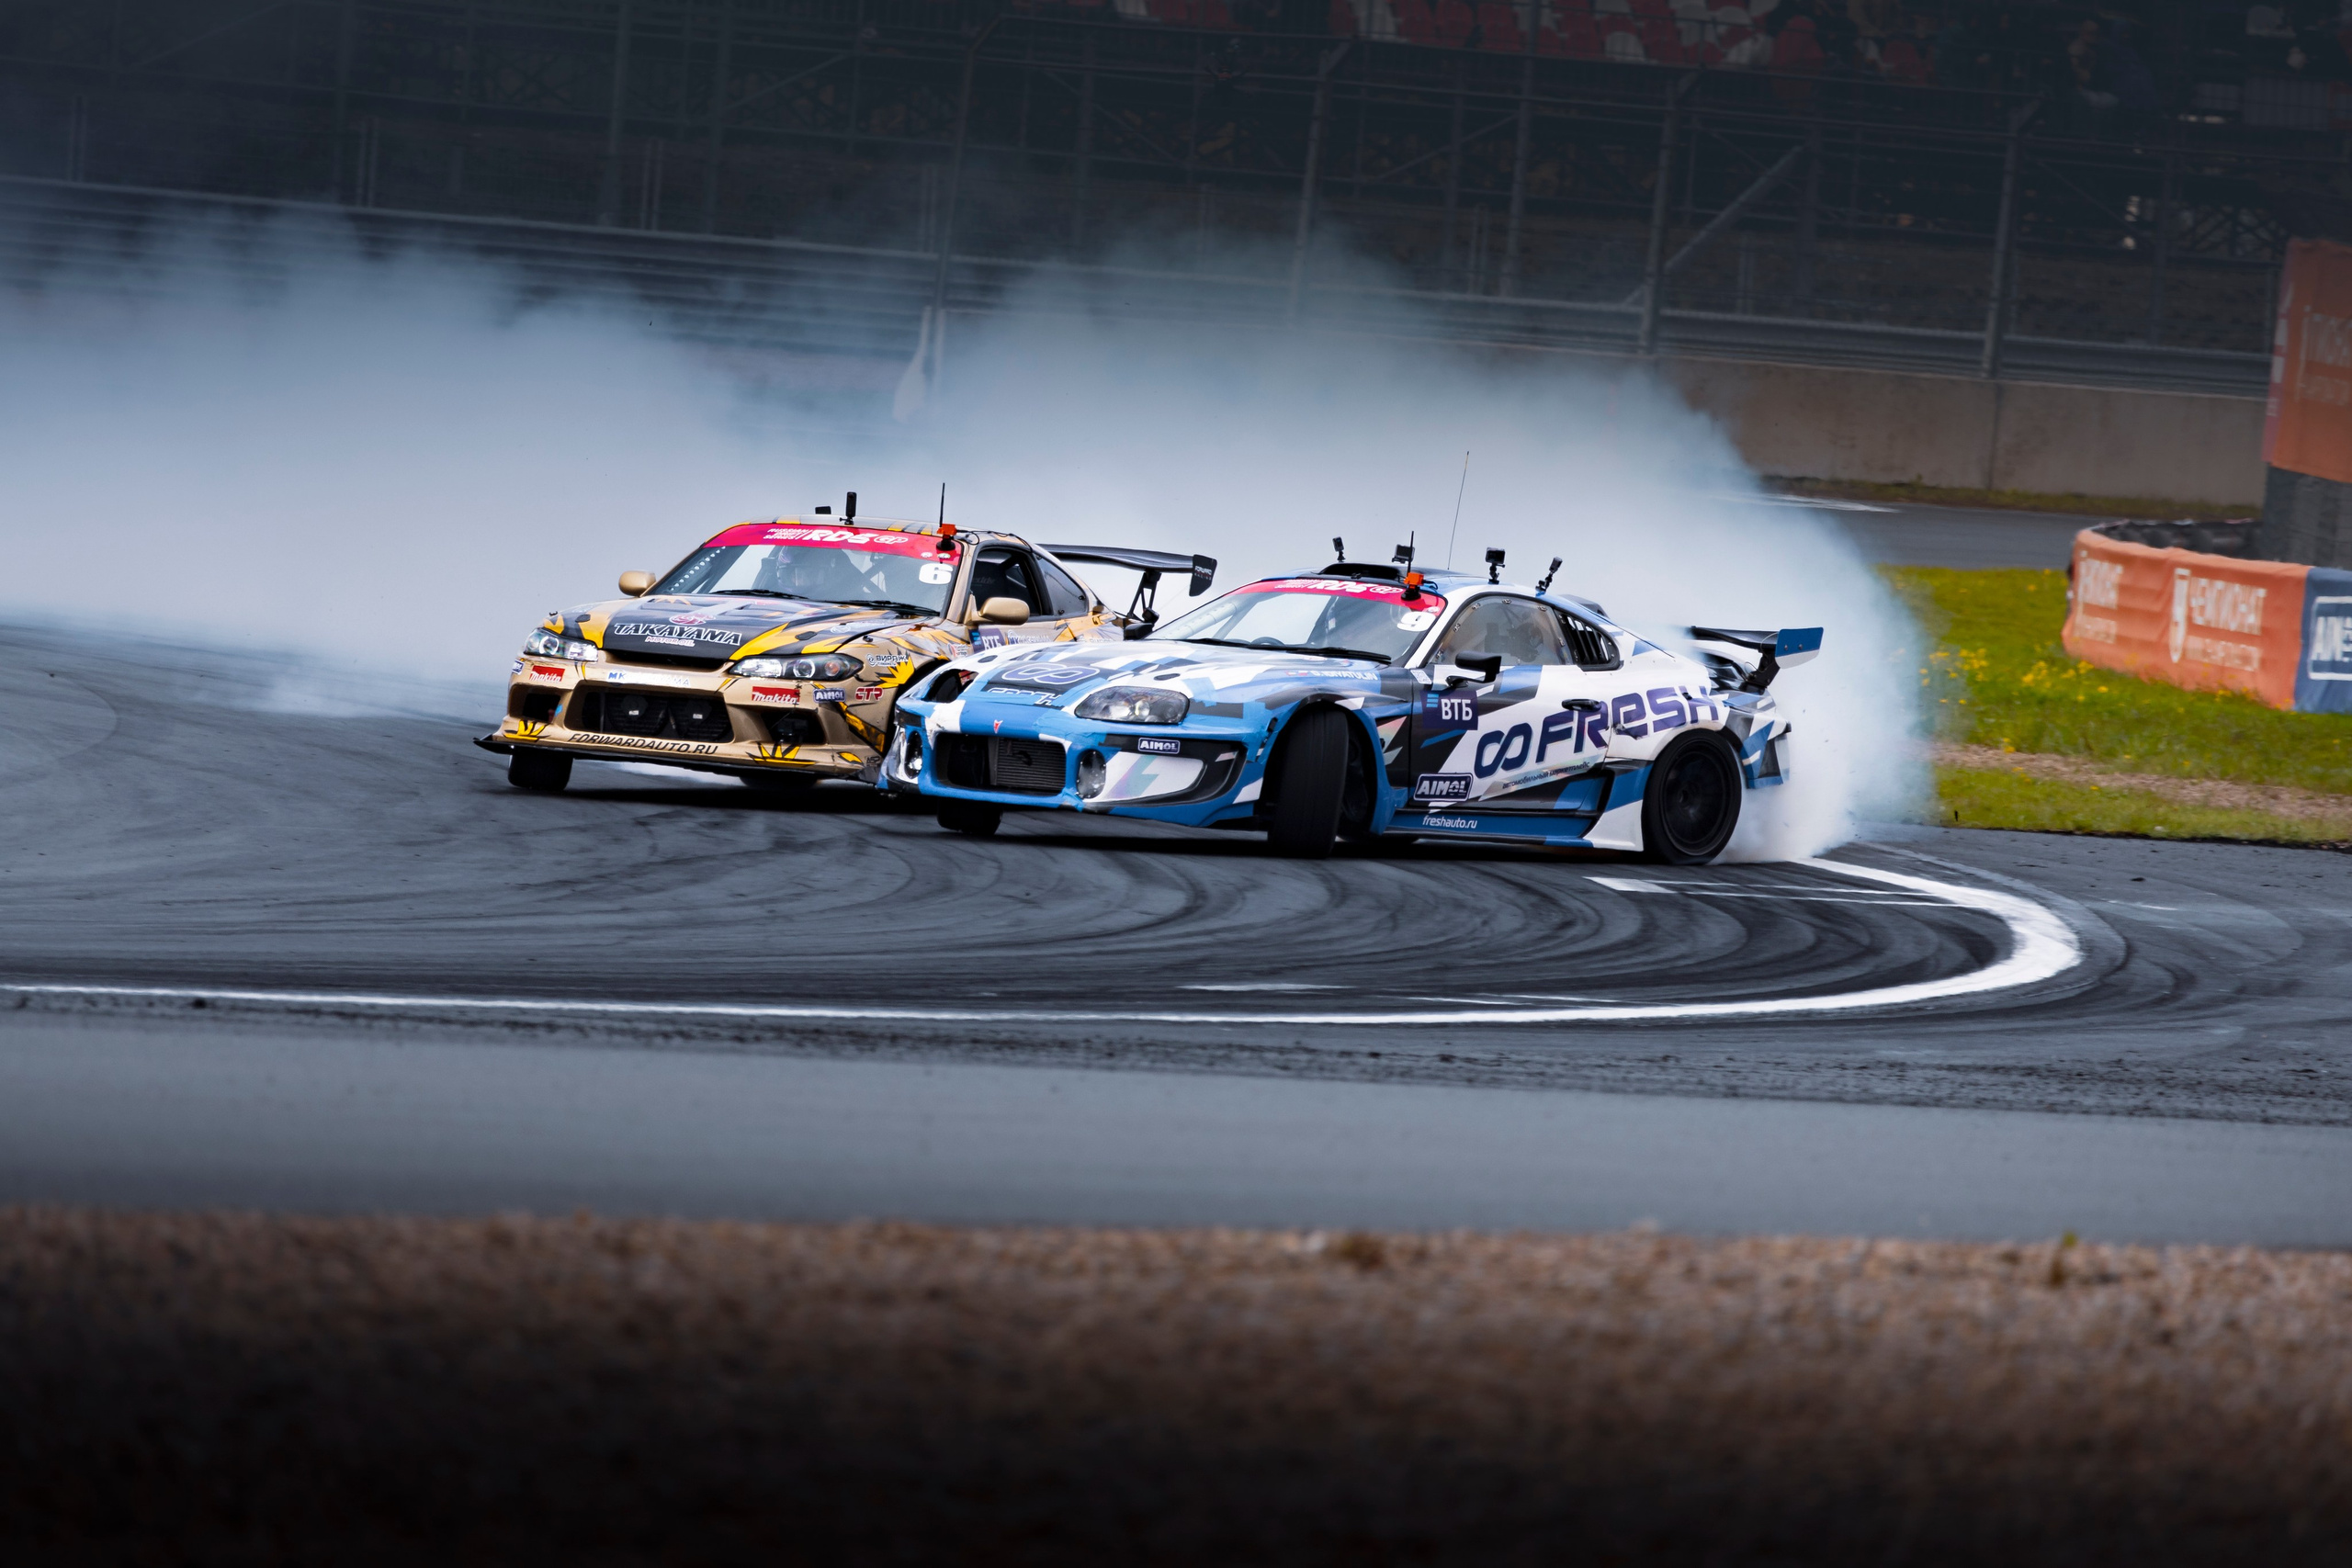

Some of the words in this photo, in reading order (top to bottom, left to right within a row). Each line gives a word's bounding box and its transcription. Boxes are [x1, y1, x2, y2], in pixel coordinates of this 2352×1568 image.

[803, 530, 879, 544] RDS
[875, 536, 908, 544] GP
[919, 563, 954, 584] 6
[1309, 580, 1376, 592] RDS
[1396, 611, 1436, 632] 9
[614, 624, 742, 646] TAKAYAMA
[1441, 699, 1473, 721] ВТБ
[568, 734, 718, 754] FORWARDAUTO.RU
[1140, 740, 1177, 750] AIMOL
[1416, 780, 1467, 796] AIMOL
[1423, 815, 1477, 829] freshauto.ru
